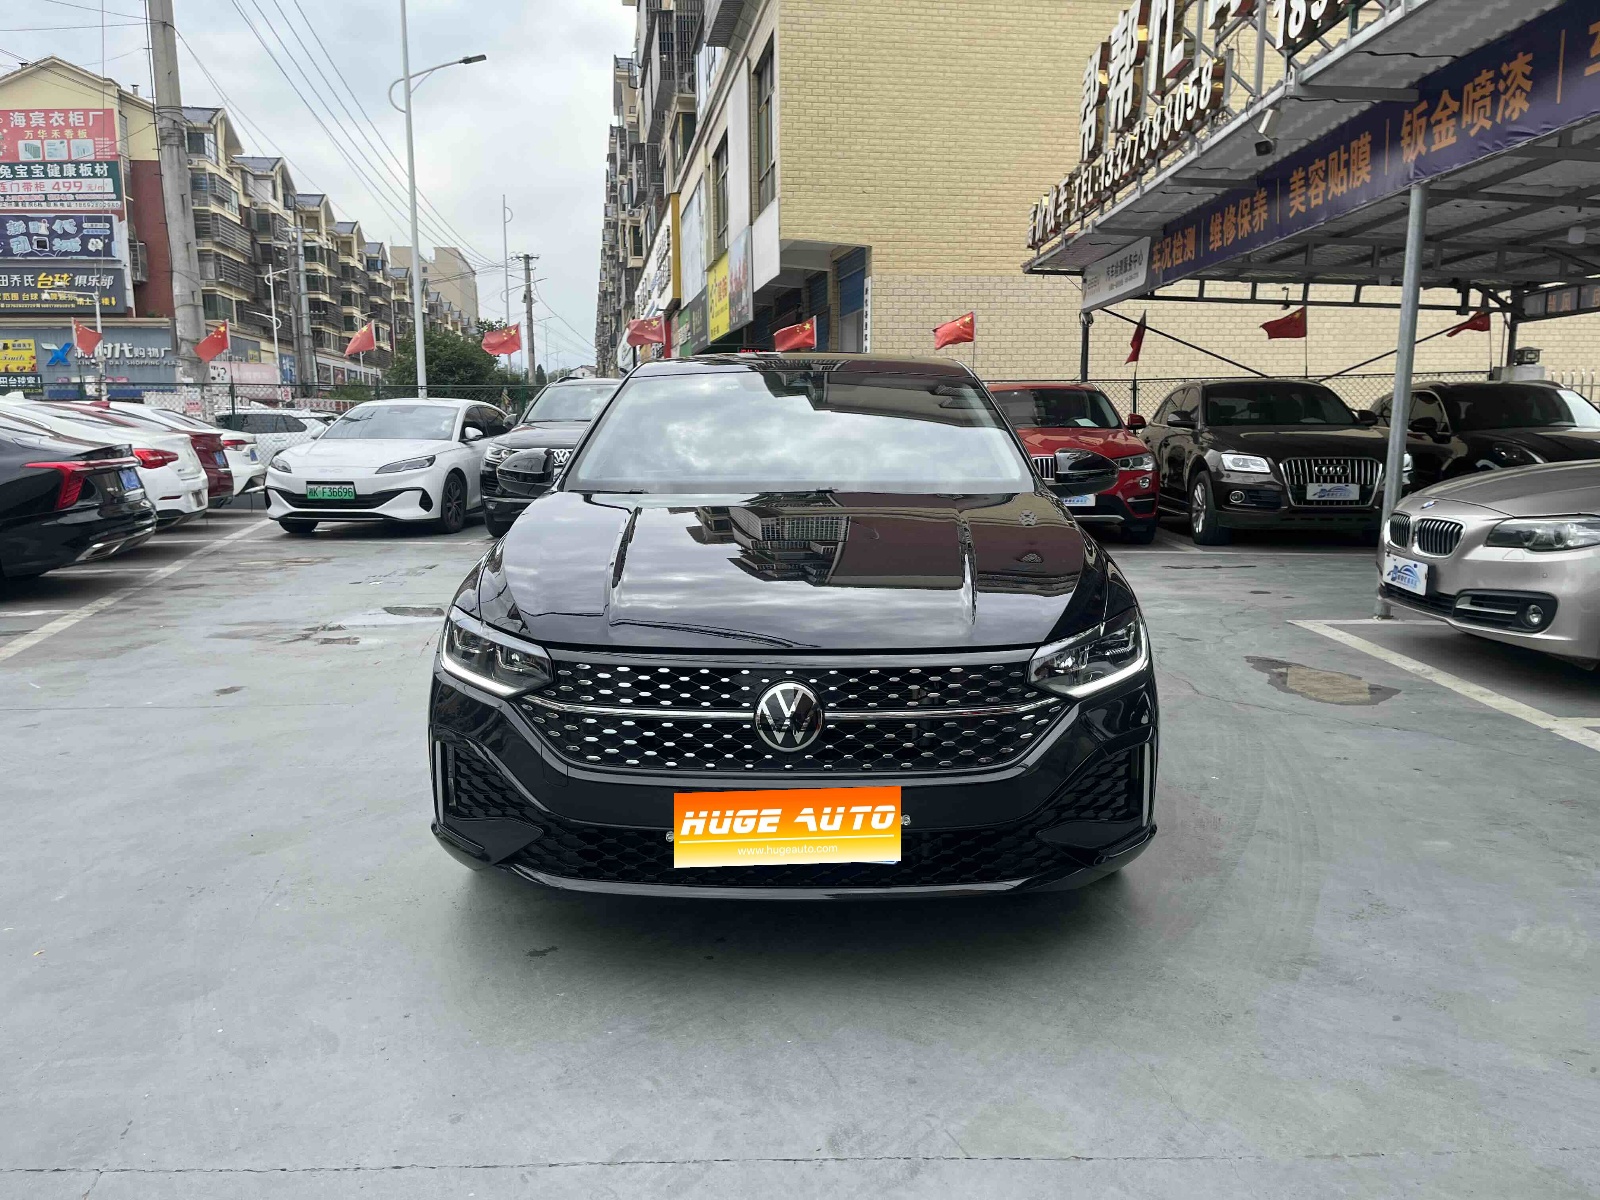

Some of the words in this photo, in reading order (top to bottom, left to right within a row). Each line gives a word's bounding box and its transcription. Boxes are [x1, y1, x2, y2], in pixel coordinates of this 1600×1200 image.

[10, 111, 104, 128] 海宾衣柜厂
[0, 163, 109, 178] 兔宝宝健康板材
[1152, 224, 1195, 274] 车况检测
[1209, 187, 1268, 251] 维修保养
[1288, 131, 1371, 218] 美容贴膜
[1401, 52, 1534, 164] 钣金喷漆
[52, 181, 83, 192] 499
